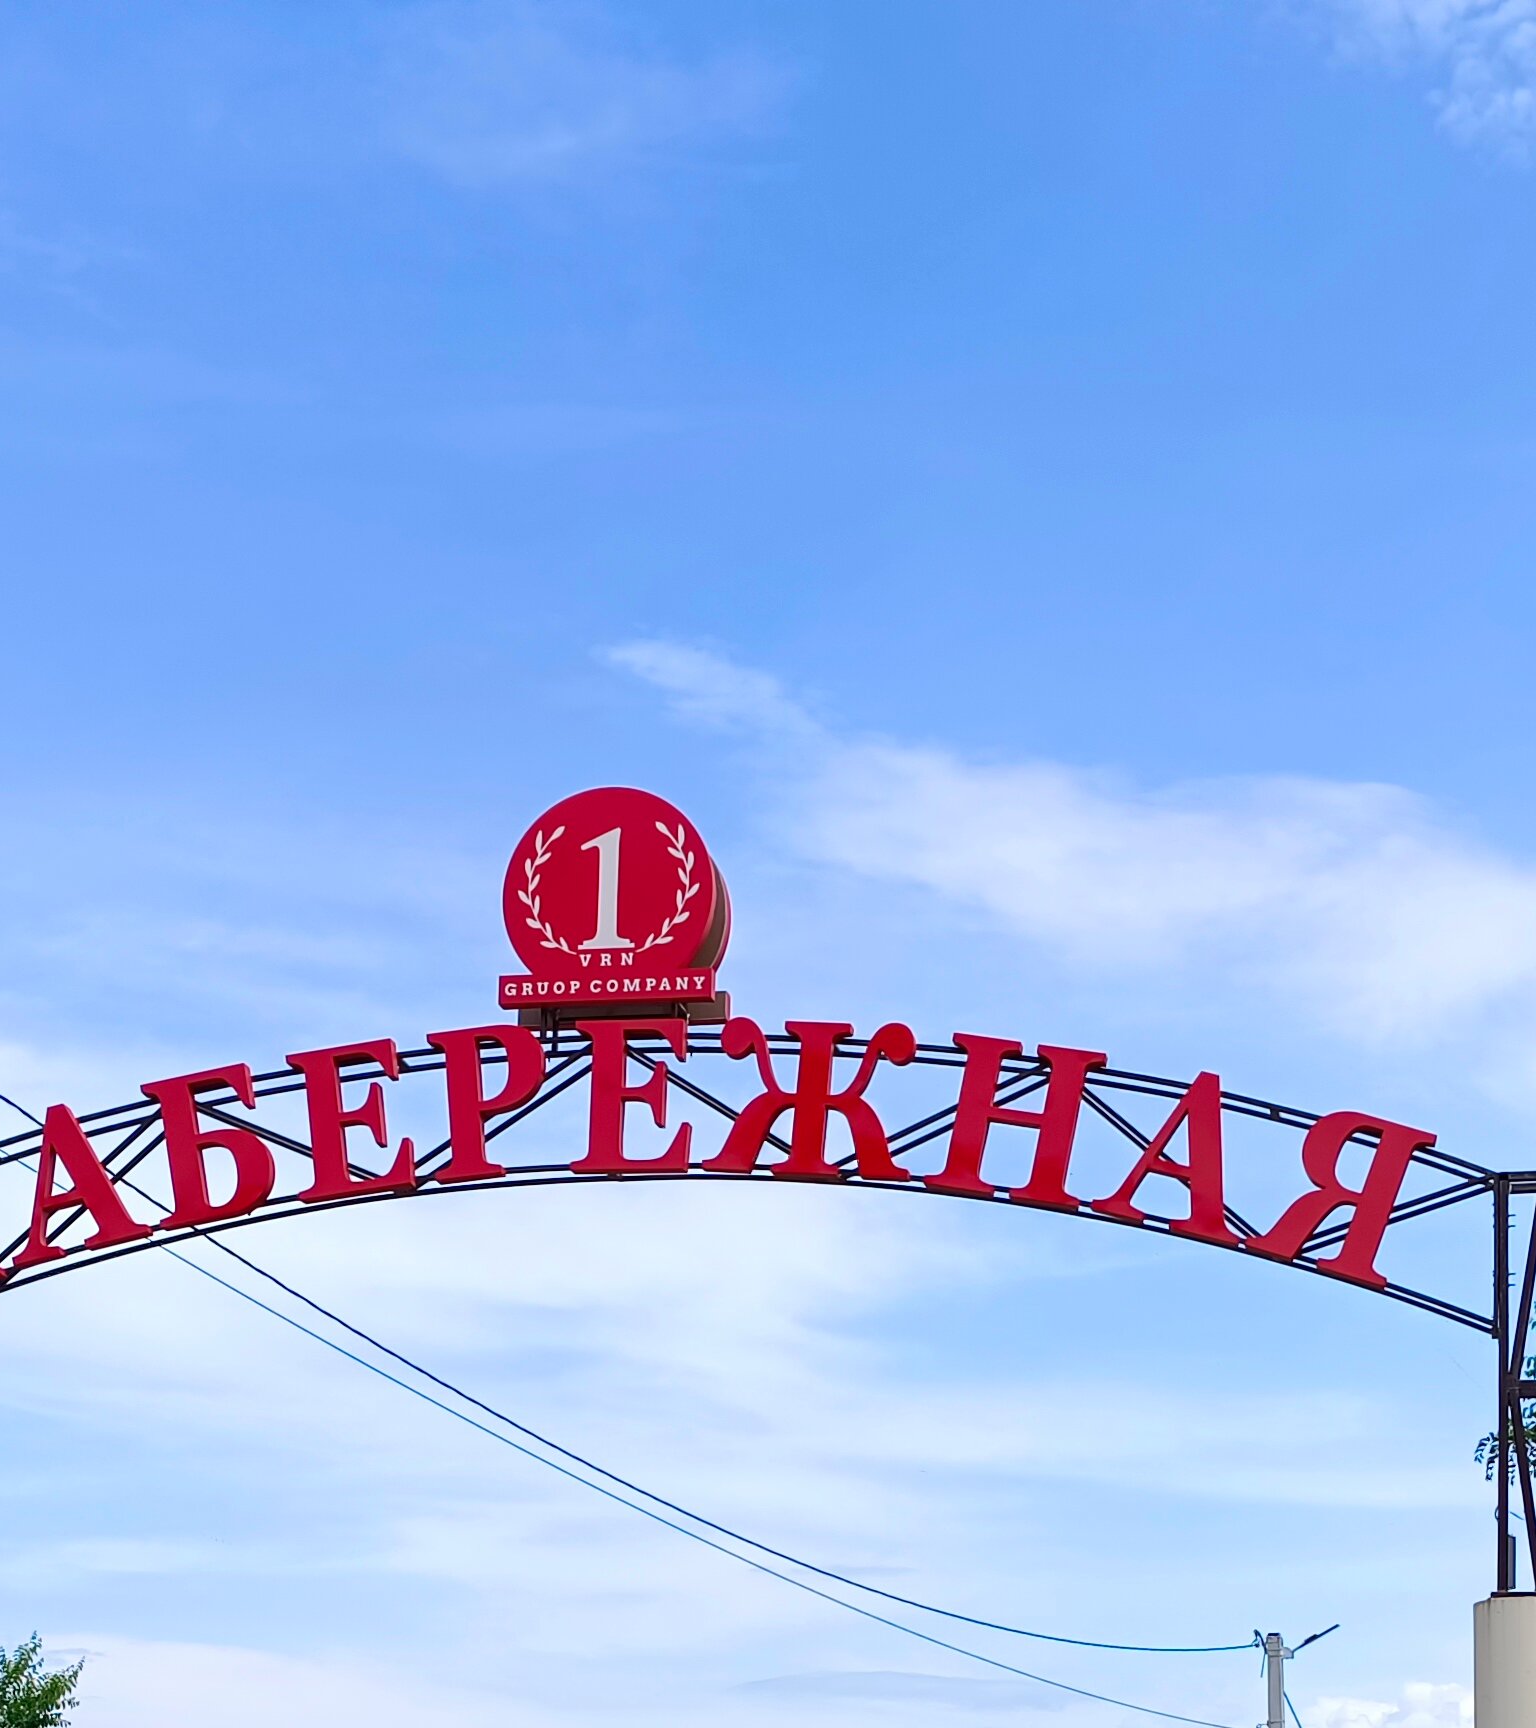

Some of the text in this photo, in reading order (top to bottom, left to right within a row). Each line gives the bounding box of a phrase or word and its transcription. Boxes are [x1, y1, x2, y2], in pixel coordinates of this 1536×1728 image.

[577, 827, 635, 950] 1
[579, 952, 635, 967] VRN
[504, 975, 706, 996] GRUOP COMPANY
